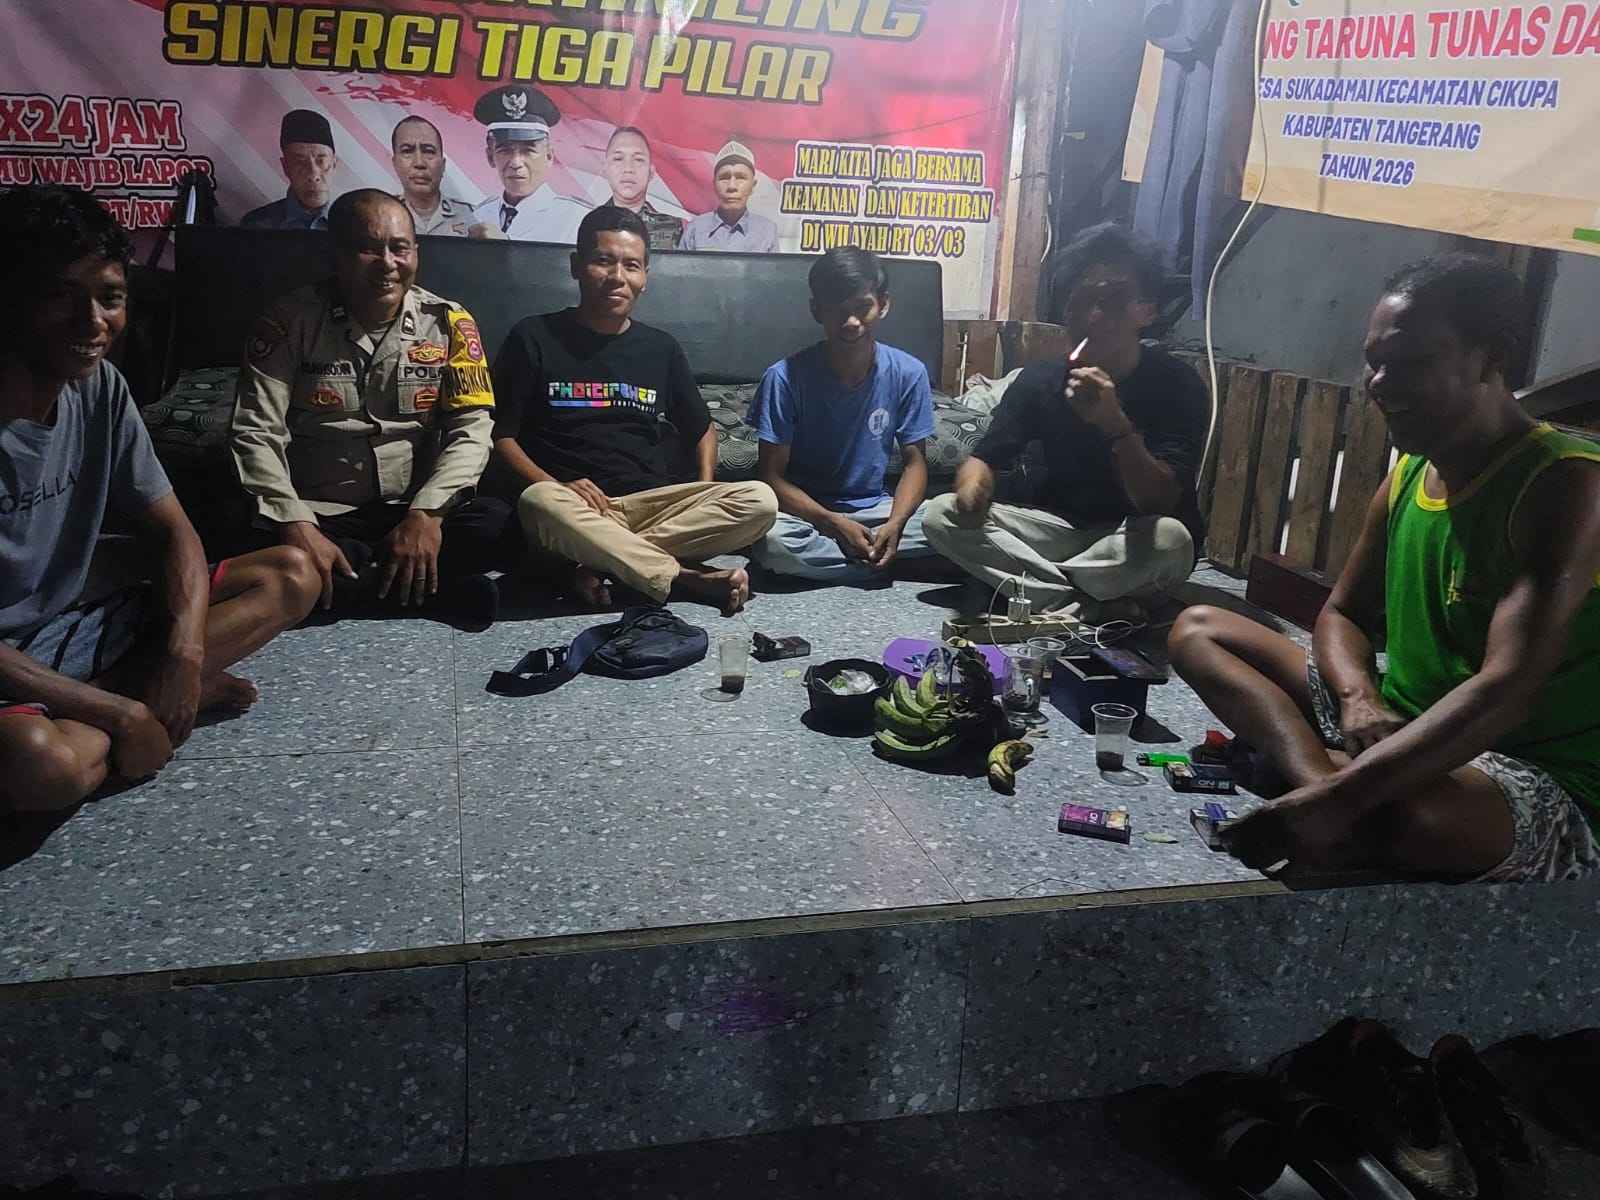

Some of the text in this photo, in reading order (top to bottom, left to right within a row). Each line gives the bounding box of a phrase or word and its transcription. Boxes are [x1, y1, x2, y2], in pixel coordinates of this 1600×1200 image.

[1304, 14, 1416, 60] TARUNA
[1427, 6, 1550, 59] TUNAS
[165, 2, 831, 103] SINERGI TIGA PILAR
[1284, 78, 1374, 103] SUKADAMAI
[1375, 79, 1486, 107] KECAMATAN
[1486, 80, 1560, 109] CIKUPA
[1281, 113, 1482, 150] KABUPATEN TANGERANG
[35, 156, 121, 191] WAJIB
[797, 145, 983, 186] MARI KITA JAGA BERSAMA
[1318, 153, 1415, 186] TAHUN 2026
[781, 183, 993, 222] KEAMANAN DAN KETERTIBAN
[802, 220, 821, 250] DI
[889, 225, 914, 255] RT
[914, 225, 966, 257] 03/03
